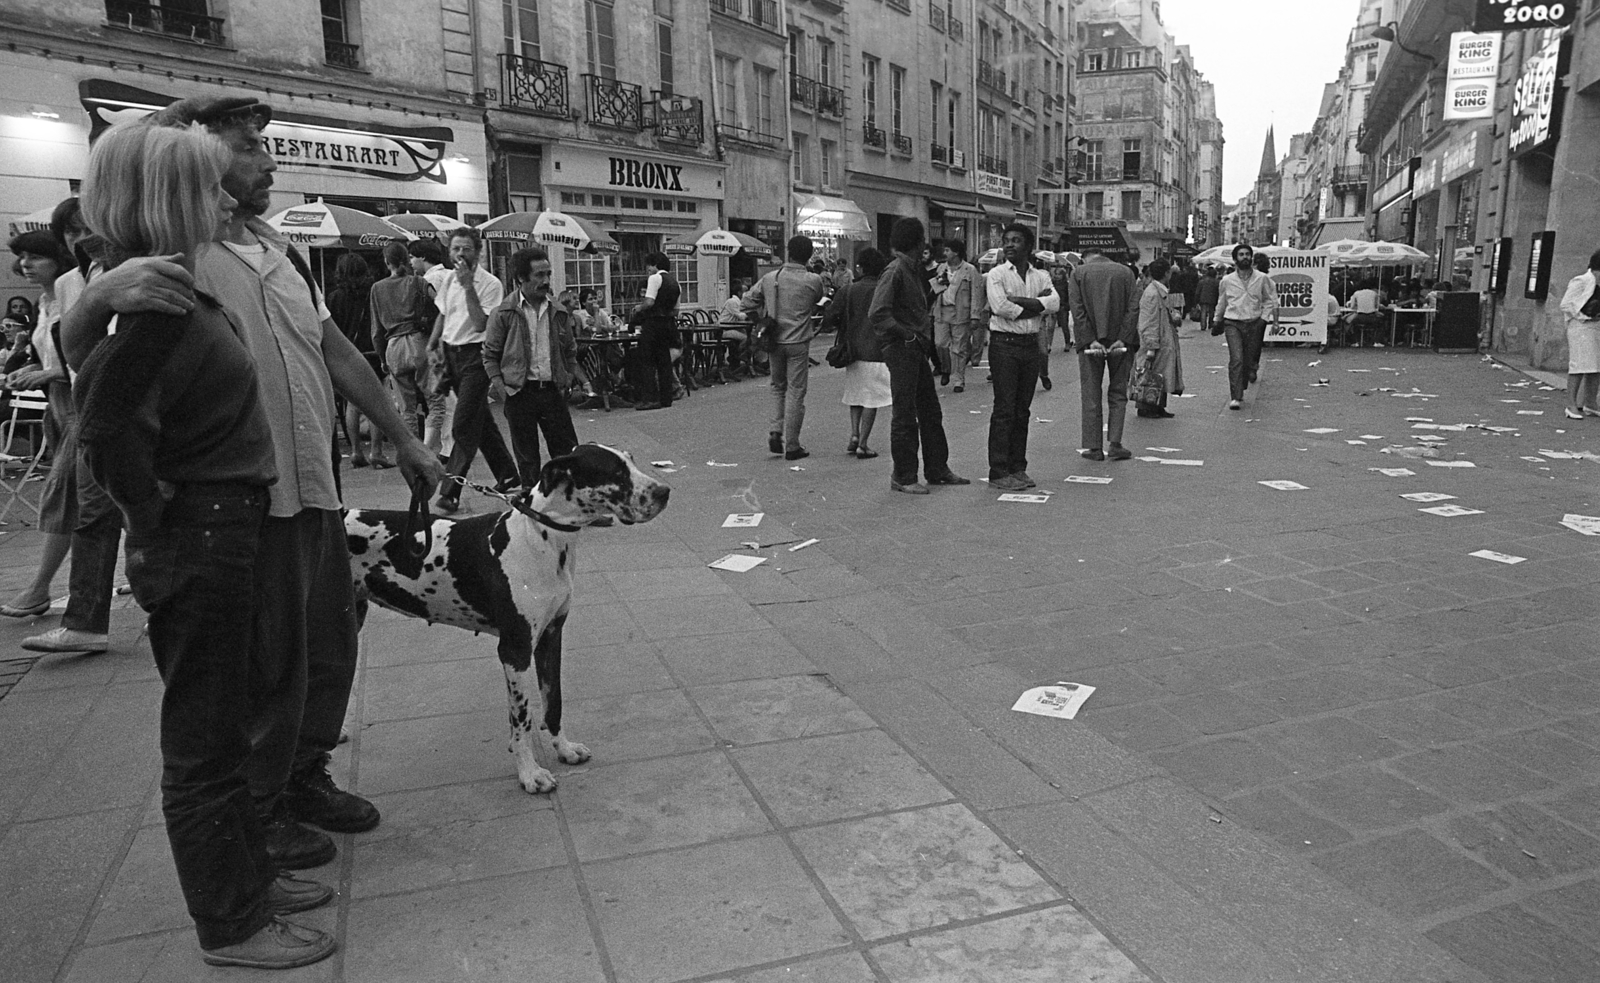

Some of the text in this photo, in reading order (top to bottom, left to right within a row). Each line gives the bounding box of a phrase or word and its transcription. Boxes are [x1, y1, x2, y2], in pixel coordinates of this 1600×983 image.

[1503, 3, 1565, 23] 2000
[1459, 40, 1493, 49] BURGER
[1458, 48, 1491, 58] KING
[1453, 65, 1495, 75] RESTAURANT
[485, 88, 496, 100] 45
[1454, 89, 1487, 98] BURGER
[1454, 97, 1487, 107] KING
[608, 157, 683, 191] BRONX
[1268, 255, 1327, 268] STAURANT
[1277, 294, 1313, 307] ING
